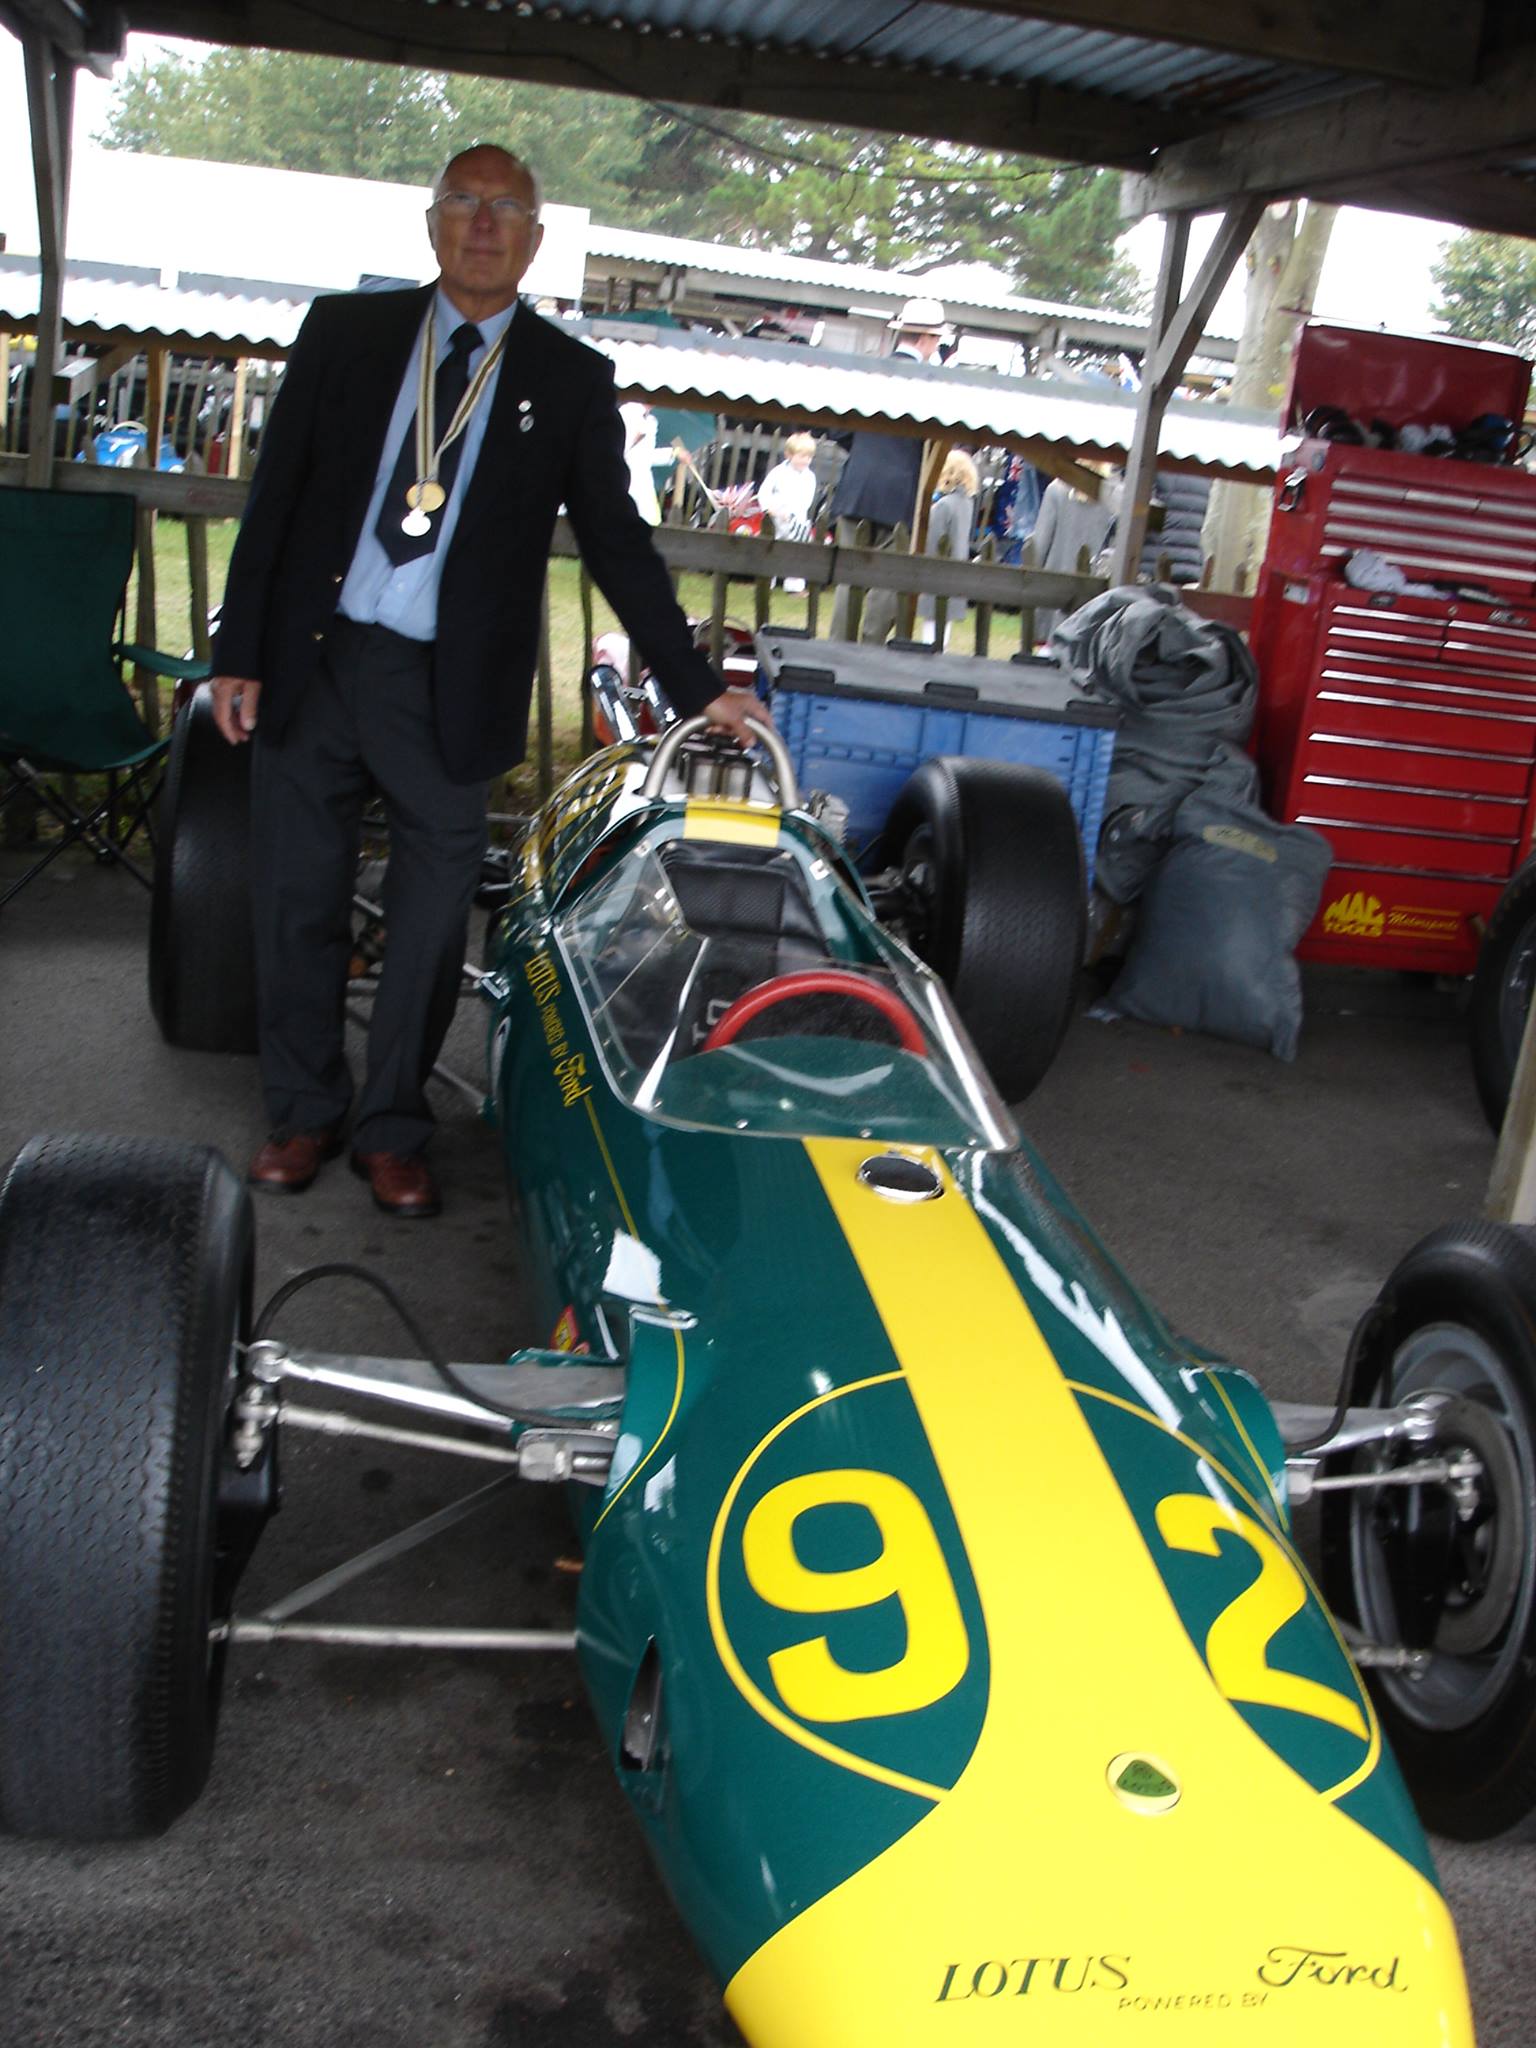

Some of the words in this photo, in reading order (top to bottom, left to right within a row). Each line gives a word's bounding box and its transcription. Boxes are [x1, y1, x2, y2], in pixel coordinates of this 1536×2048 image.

[1324, 891, 1385, 925] MAC
[524, 951, 561, 1007] LOTUS
[553, 1053, 593, 1107] Ford
[742, 1468, 970, 1723] 9
[1155, 1493, 1370, 1741] 2
[935, 1954, 1131, 2003] LOTUS
[1118, 1993, 1231, 2011] POWERED
[1242, 1992, 1268, 2008] BY
[1256, 1946, 1409, 1993] Ford
